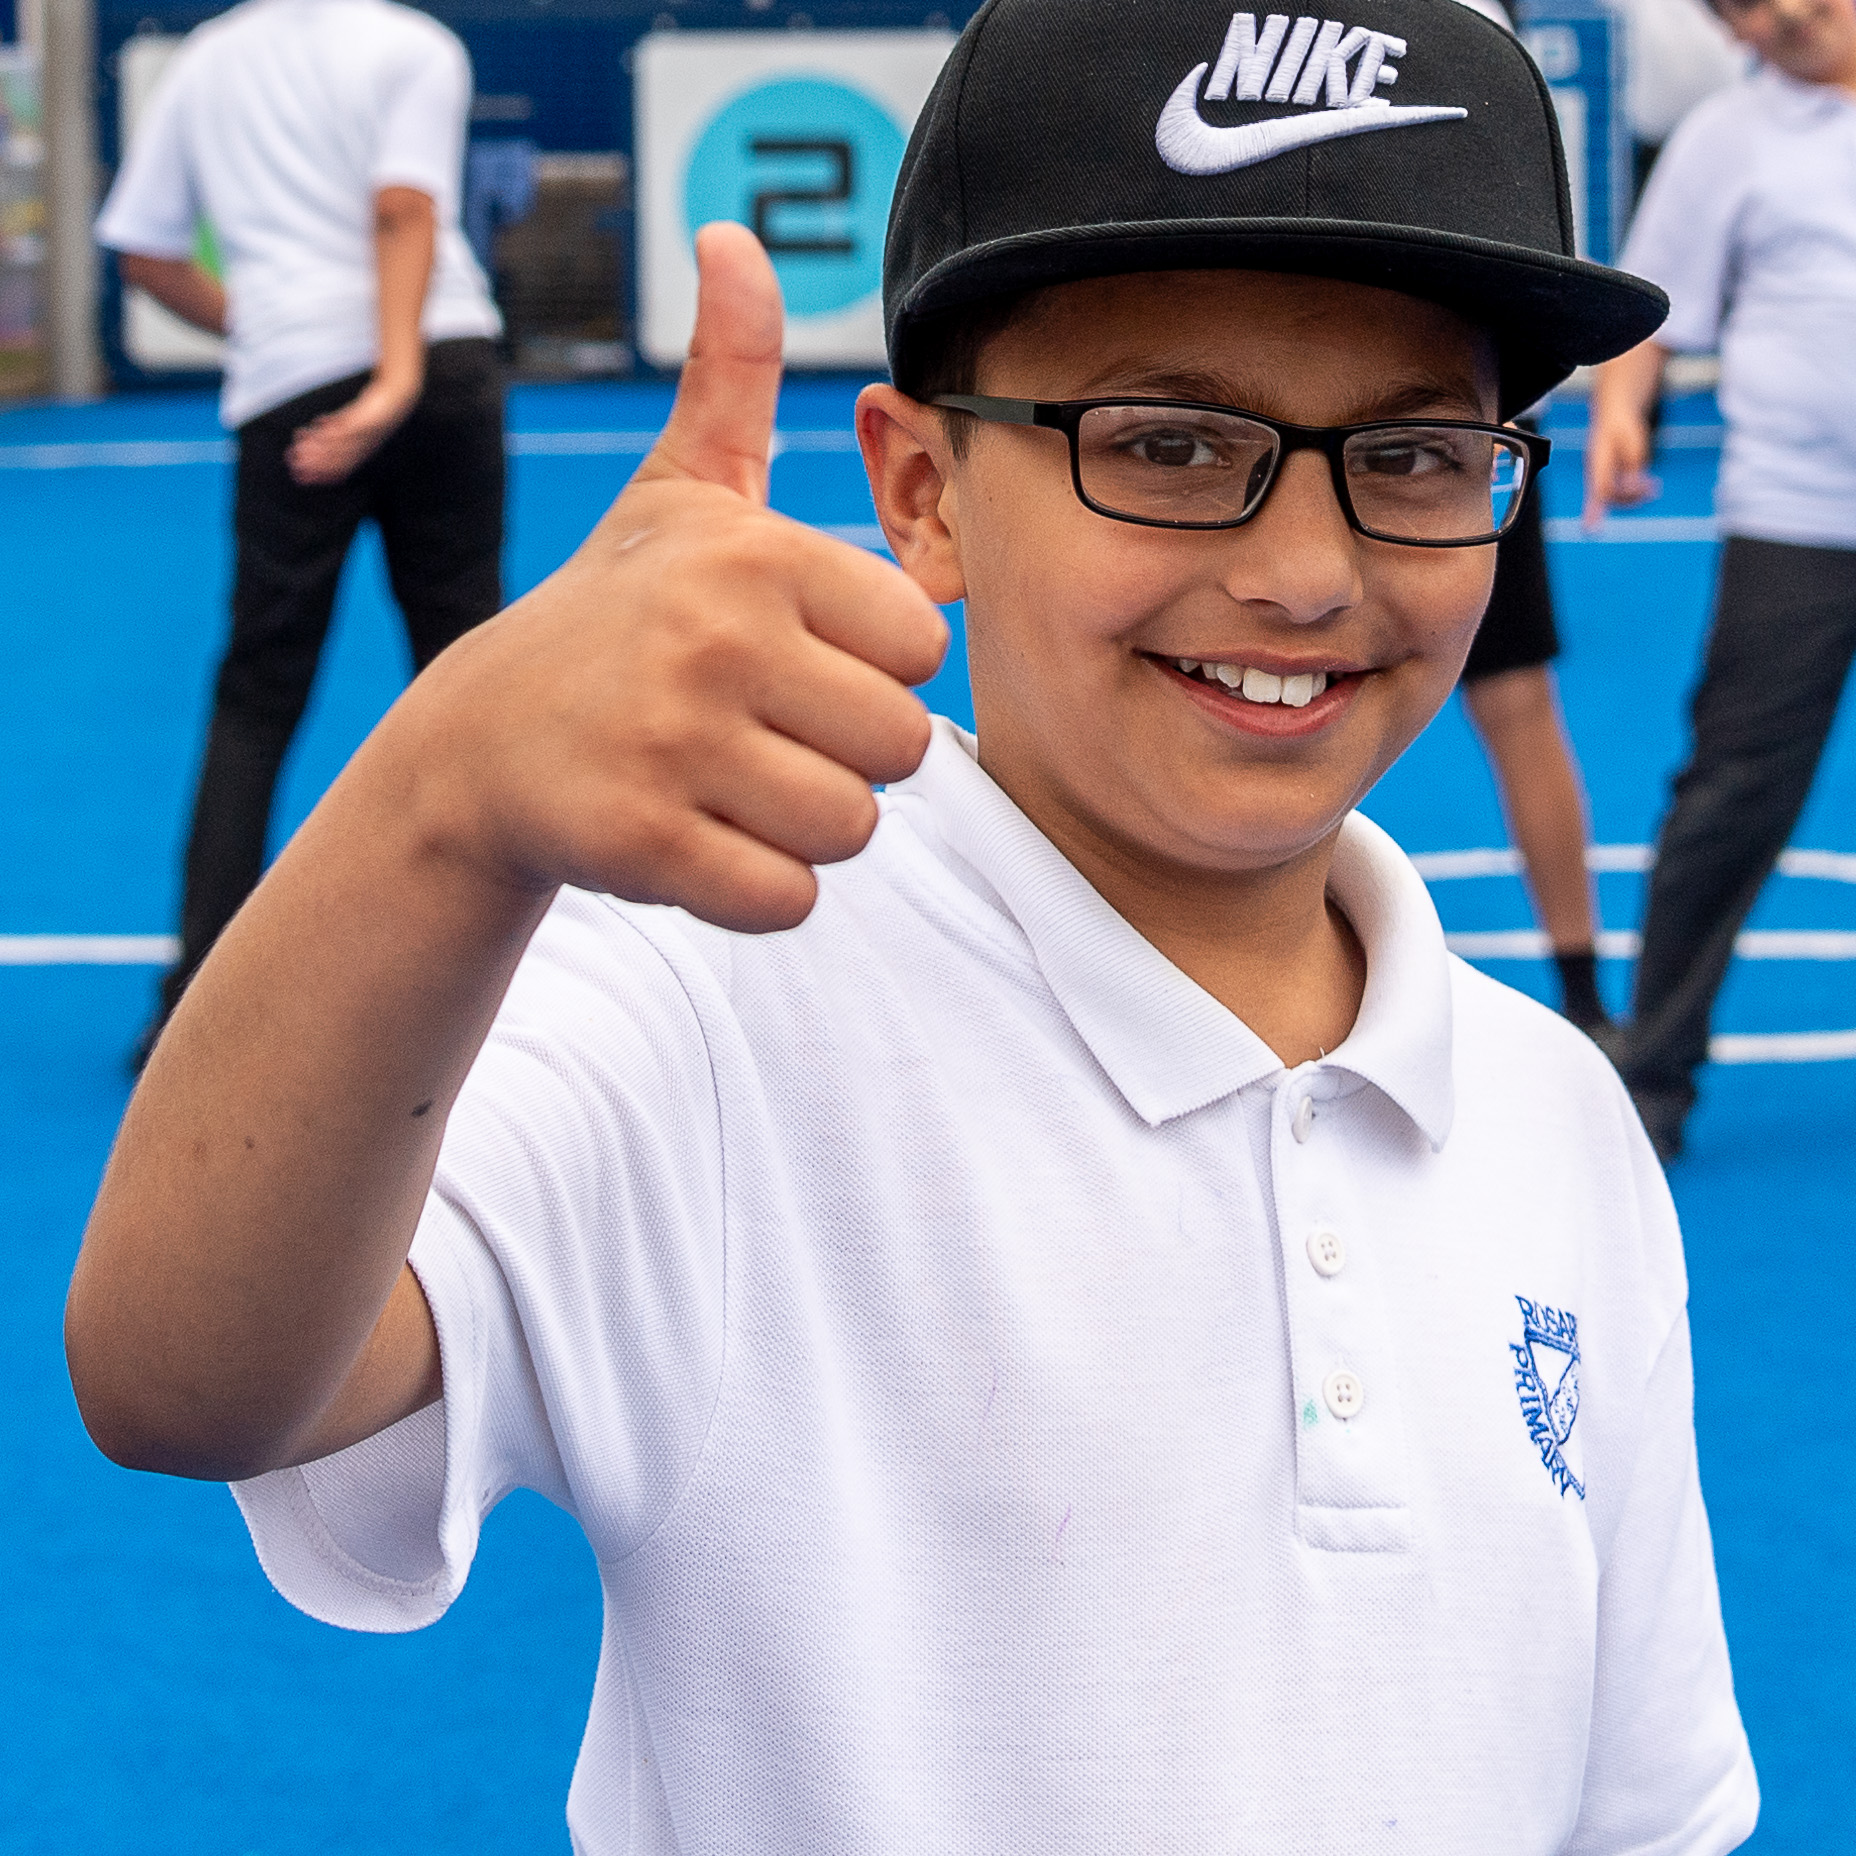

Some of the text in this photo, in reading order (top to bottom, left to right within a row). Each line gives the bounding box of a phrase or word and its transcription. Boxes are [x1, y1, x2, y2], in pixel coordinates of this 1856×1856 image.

[1204, 12, 1408, 110] NIKE
[748, 136, 854, 254] 2
[1513, 1294, 1578, 1347] ROSAR
